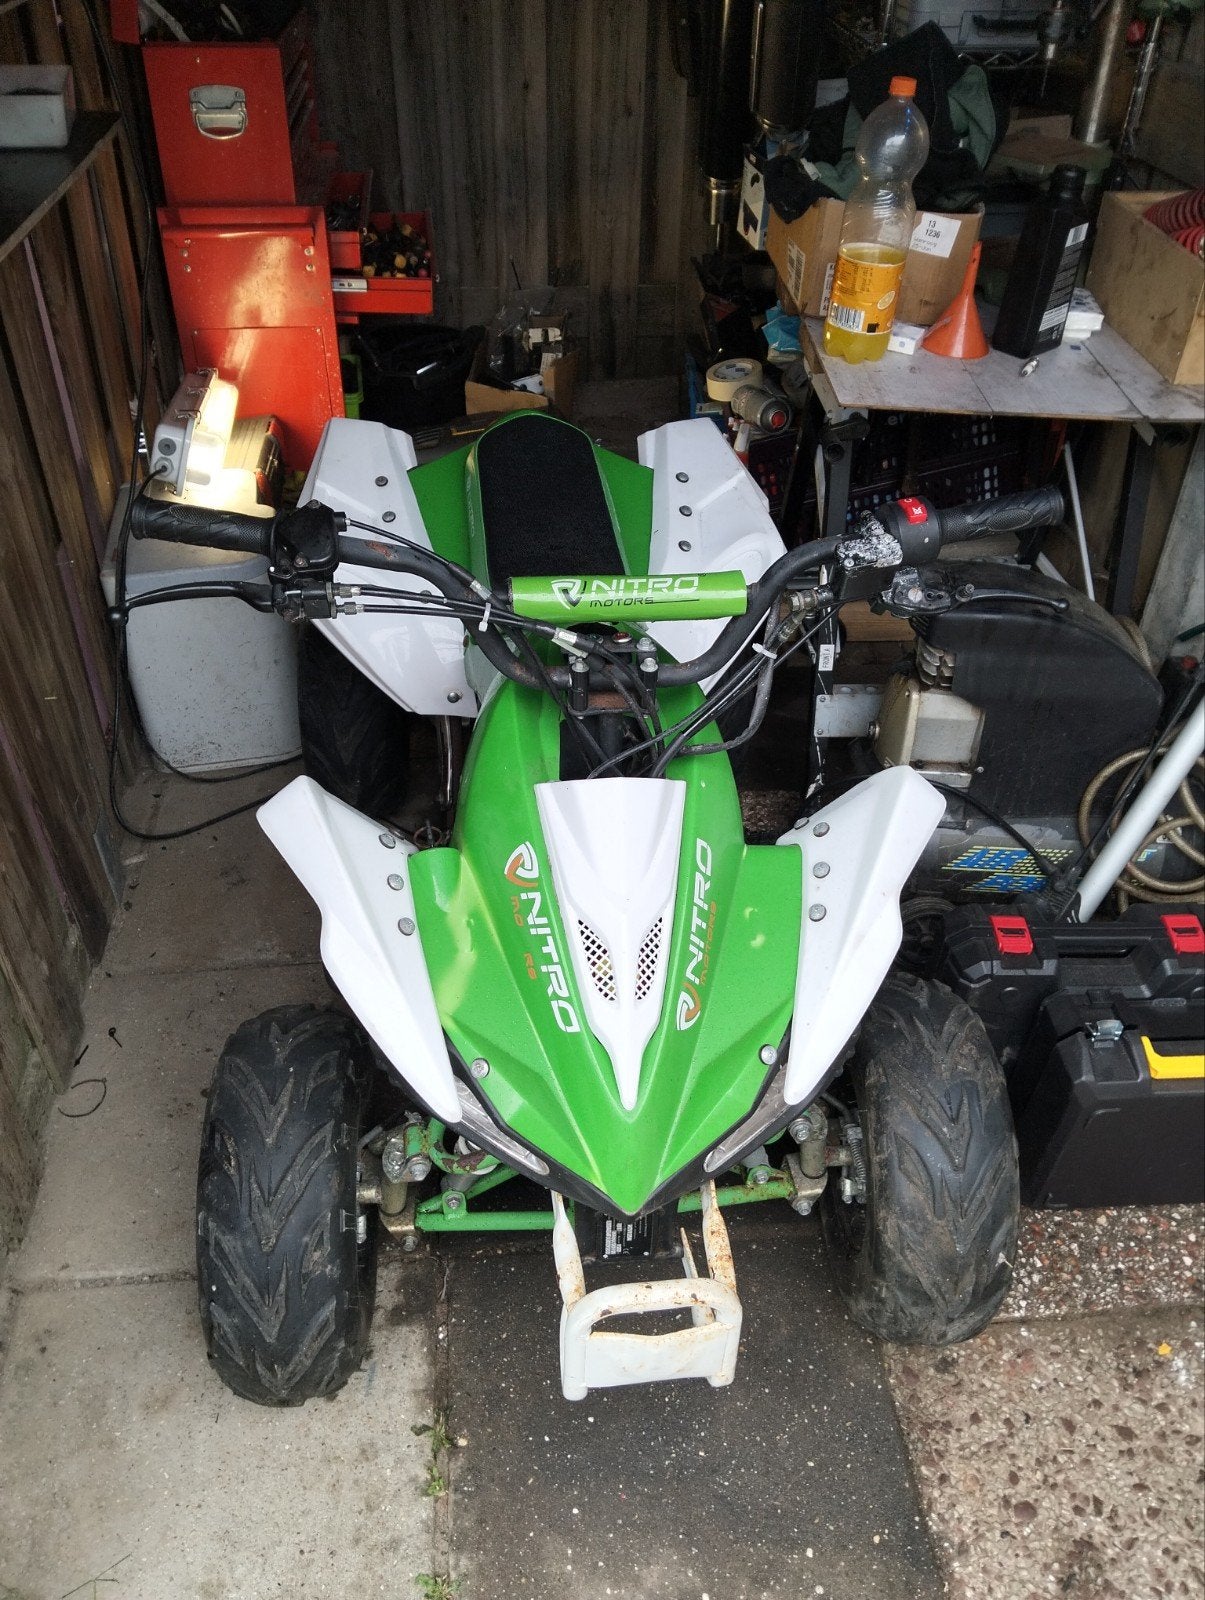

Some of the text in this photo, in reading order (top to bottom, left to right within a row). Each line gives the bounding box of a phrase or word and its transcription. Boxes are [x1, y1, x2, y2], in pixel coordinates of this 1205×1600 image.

[589, 596, 654, 608] MOTORS
[590, 576, 699, 598] NITRO
[685, 837, 713, 985] NITRO
[520, 891, 581, 1033] NITRO
